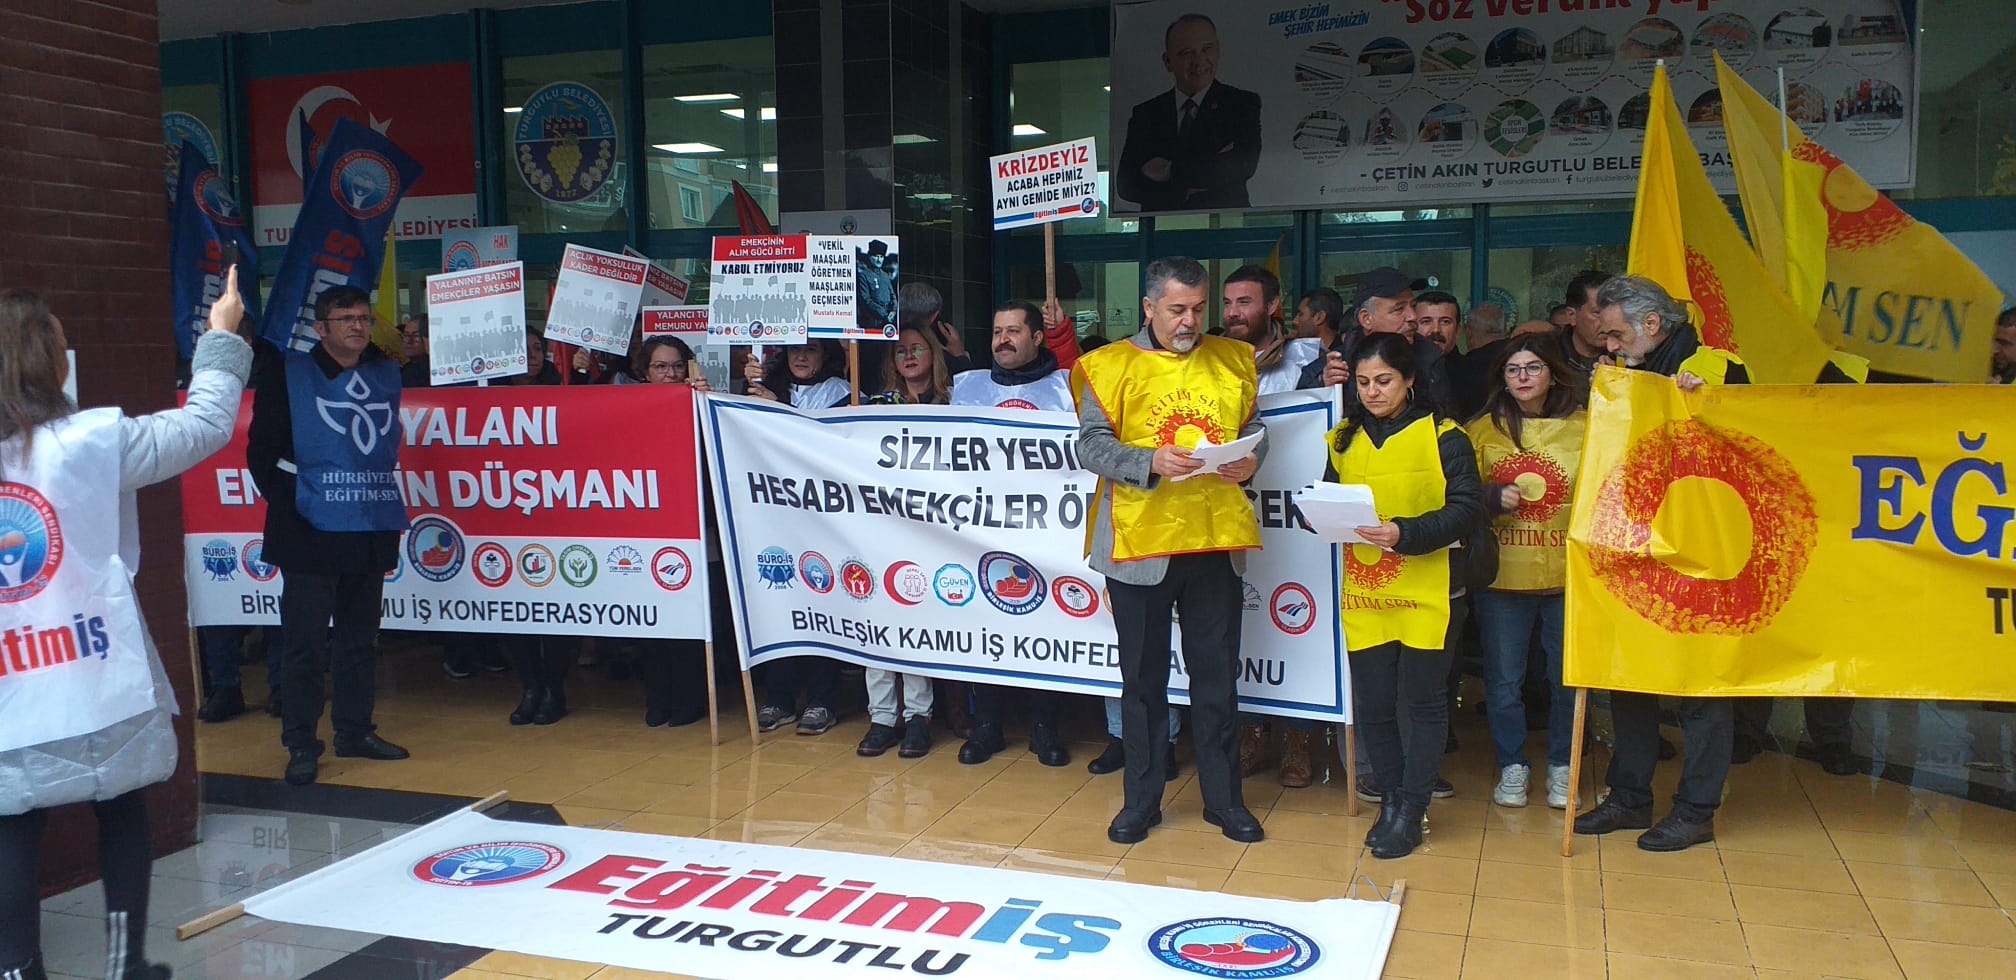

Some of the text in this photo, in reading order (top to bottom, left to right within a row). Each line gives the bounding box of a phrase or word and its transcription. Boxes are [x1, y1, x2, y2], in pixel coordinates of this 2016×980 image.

[1268, 3, 1330, 26] EMEK BİZİM
[519, 88, 559, 139] TURGUTLU
[998, 144, 1089, 179] KRİZDEYİZ
[1372, 163, 1426, 182] ÇETİN
[1432, 163, 1478, 179] AKIN
[1484, 158, 1587, 175] TURGUTLU
[1007, 166, 1083, 193] ACABA HEPİMİZ
[996, 182, 1096, 211] AYNI GEMİDE MİYİZ?
[729, 246, 795, 257] ALIM GÜCÜ BİTTİ
[741, 238, 785, 247] EMEKÇİNİN
[570, 250, 643, 273] AÇLIK YOKSULLUK
[721, 260, 805, 275] KABUL ETMİYORUZ
[812, 254, 850, 265] MAAŞLARI
[434, 270, 517, 291] YALANINIZ BATSIN
[569, 261, 639, 284] KADER DEĞİLDİR
[811, 266, 852, 279] ÖĞRETMEN
[431, 282, 520, 303] EMEKÇİLER YAŞASIN
[809, 281, 855, 294] MAAŞLARINI
[656, 309, 708, 320] YALANCI TÜ
[813, 309, 853, 317] Mustafa Kemal
[1868, 290, 1975, 352] SEN
[654, 322, 692, 330] MEMURU
[1145, 387, 1219, 428] EĞİTİM SE
[399, 406, 559, 446] YALANI
[877, 428, 1087, 472] SİZLER YEDİ
[449, 461, 660, 516] DÜŞMANI
[747, 472, 855, 514] HESABI
[859, 483, 1048, 532] EMEKÇİLER
[1493, 525, 1568, 548] ĞİTİM SE
[412, 594, 432, 625] İŞ
[439, 600, 658, 627] KONFEDERASYONU
[1385, 598, 1418, 610] SEN
[791, 606, 892, 648] BİRLEŞİK
[898, 627, 973, 654] KAMU
[982, 627, 1005, 662] İŞ
[544, 854, 1122, 960] Eğitimiş
[596, 912, 972, 976] TURGUTLU
[1161, 950, 1296, 979] BİRLEŞİK KAMU-İŞ
